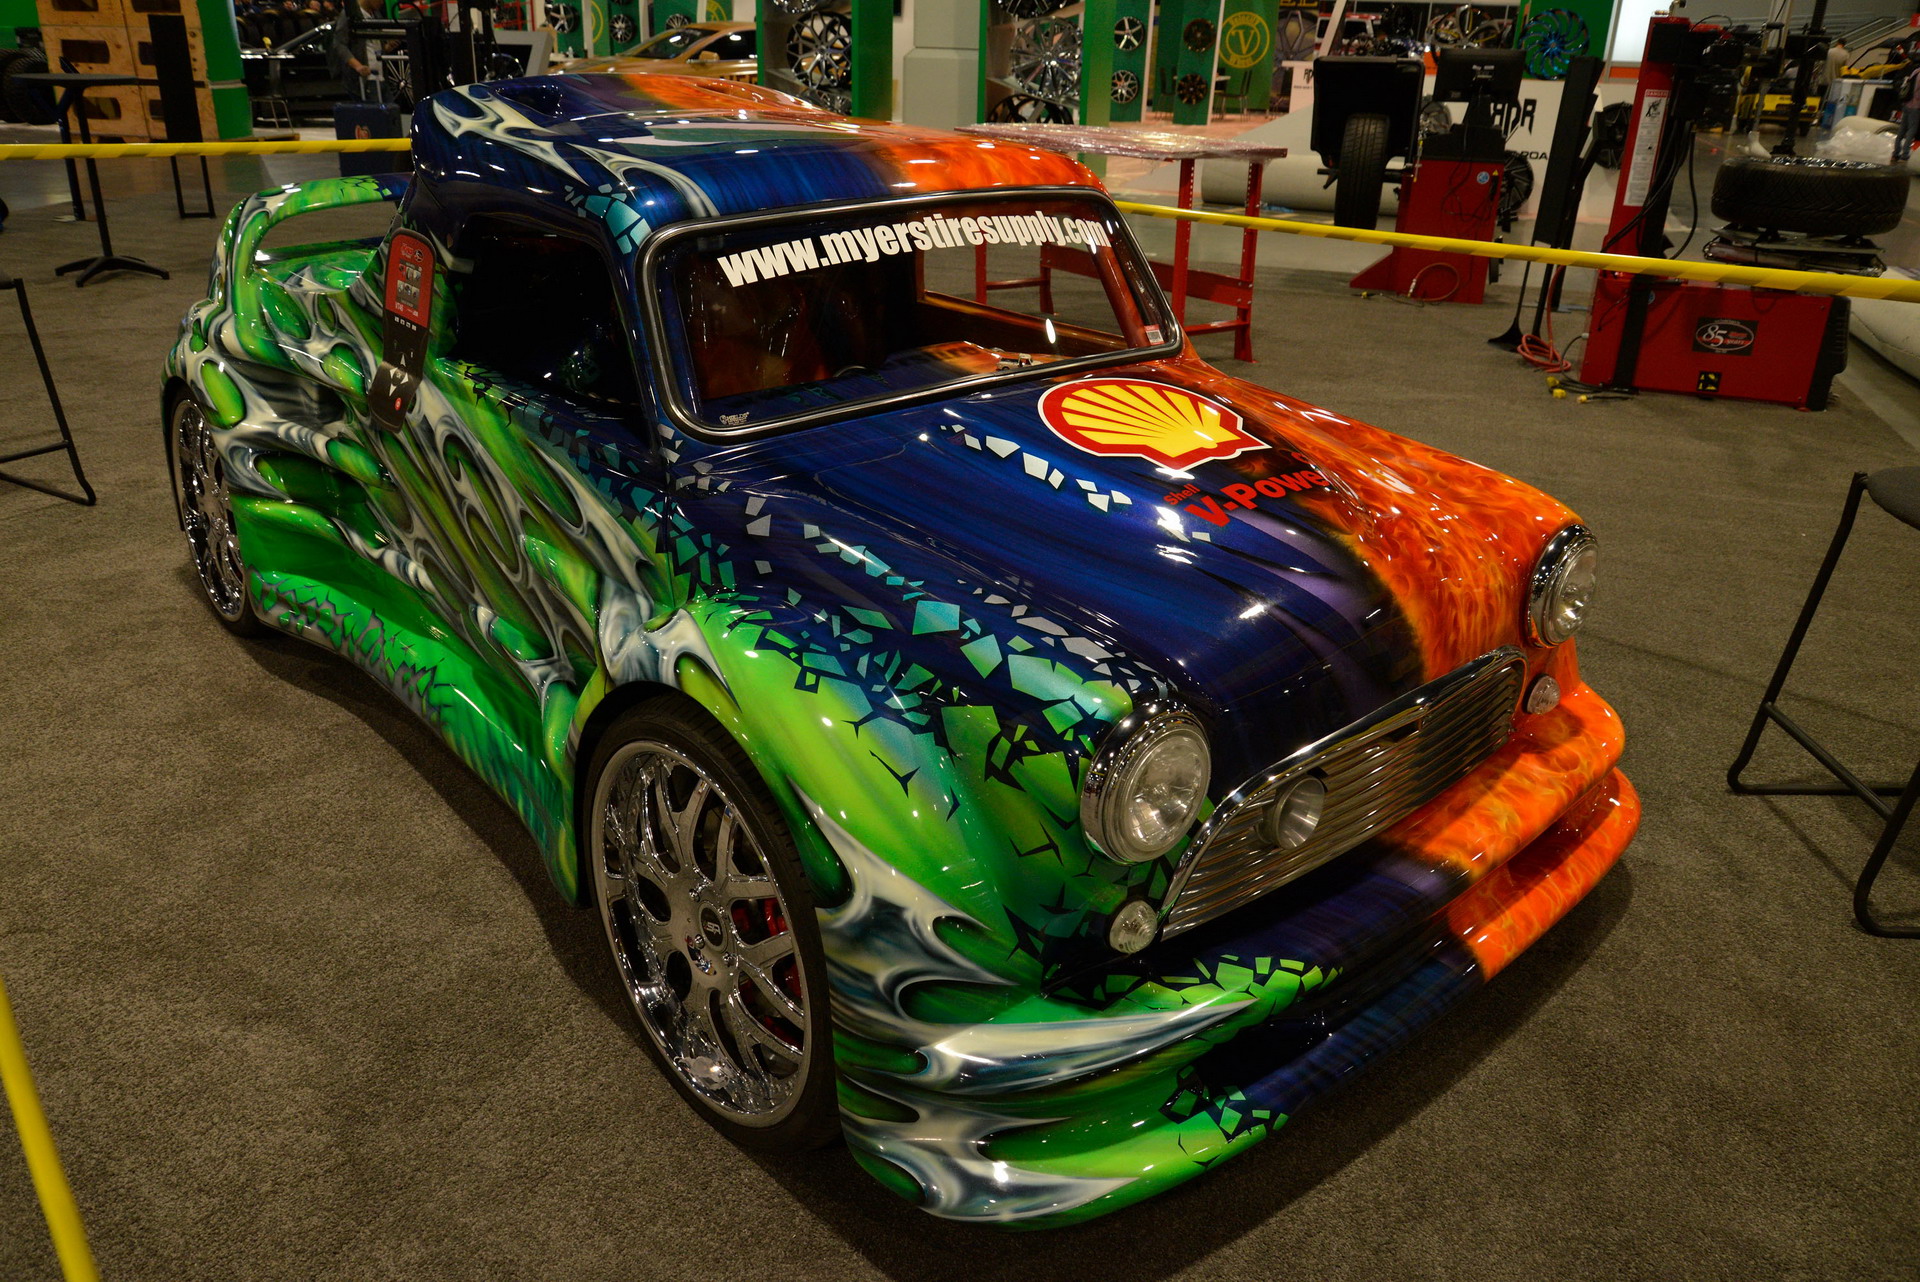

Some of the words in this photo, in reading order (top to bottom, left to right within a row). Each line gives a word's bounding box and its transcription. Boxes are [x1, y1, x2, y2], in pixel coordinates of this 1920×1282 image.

[1520, 151, 1549, 161] ROA
[717, 210, 1112, 288] www.myerstiresupply.com
[1703, 325, 1727, 346] 85
[1163, 483, 1201, 506] Shell
[1184, 469, 1331, 528] V-Powe
